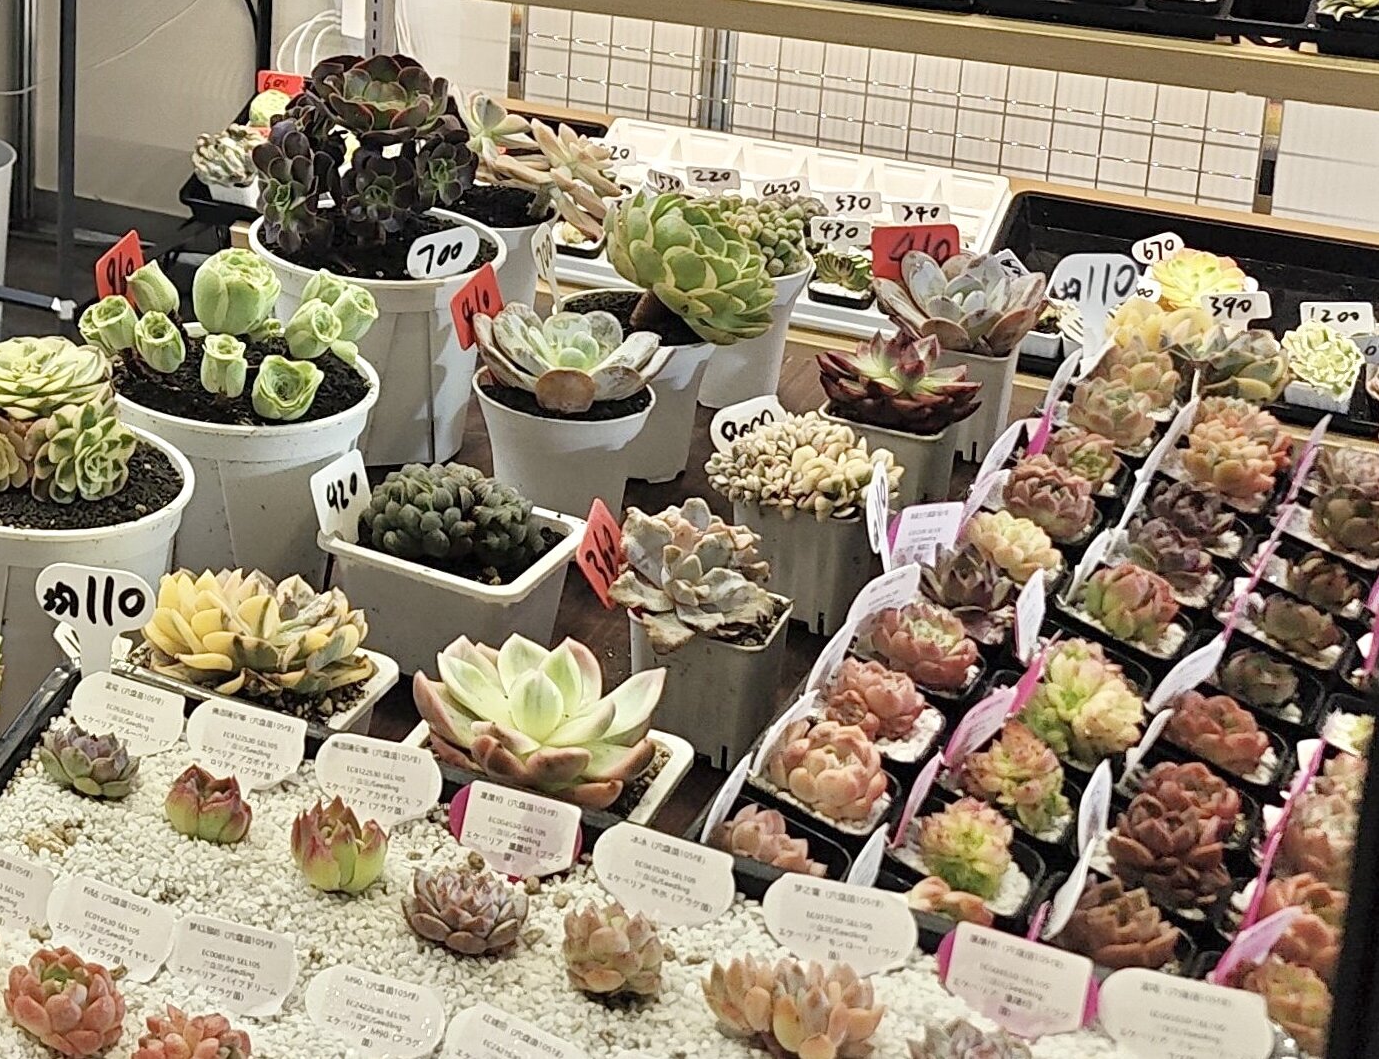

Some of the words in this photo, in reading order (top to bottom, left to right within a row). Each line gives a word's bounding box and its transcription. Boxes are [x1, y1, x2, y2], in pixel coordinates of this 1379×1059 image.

[692, 170, 731, 183] 220
[819, 222, 859, 240] 430
[416, 241, 463, 275] 700
[1143, 239, 1175, 262] 670
[1208, 296, 1253, 317] 390
[1309, 306, 1360, 323] 1200
[326, 471, 358, 515] 420
